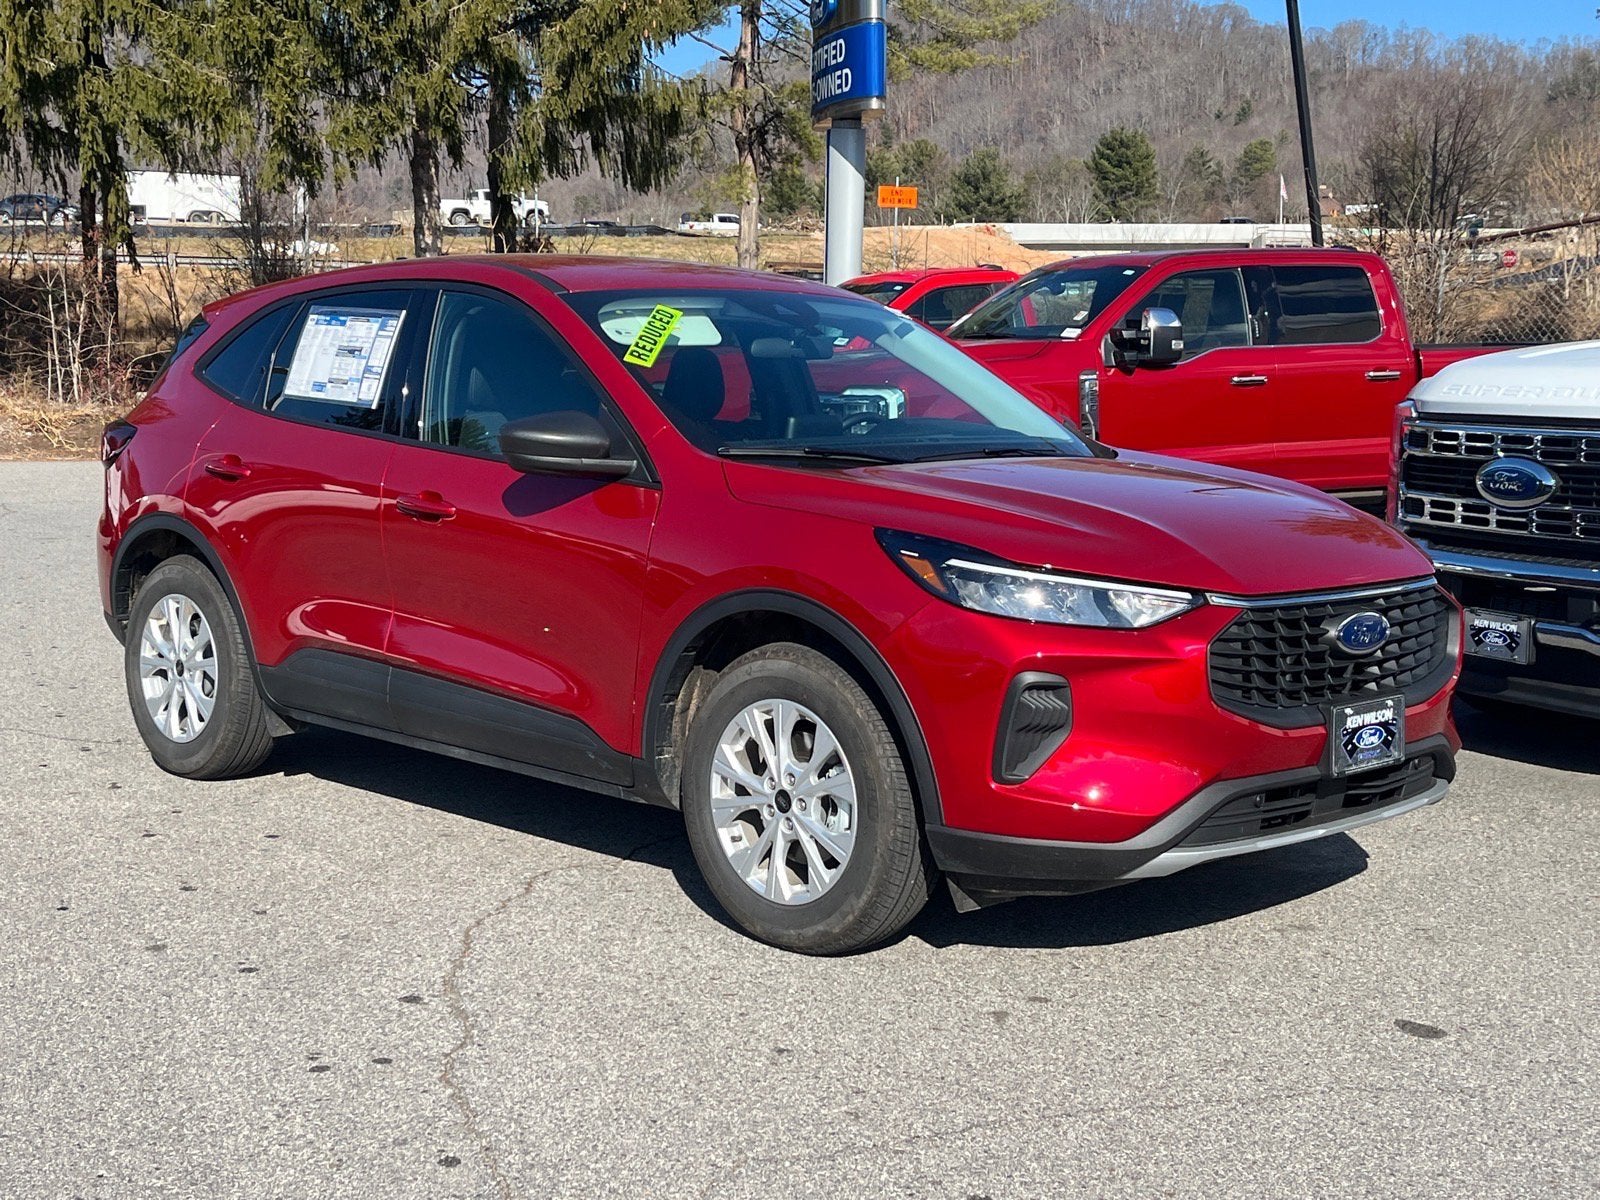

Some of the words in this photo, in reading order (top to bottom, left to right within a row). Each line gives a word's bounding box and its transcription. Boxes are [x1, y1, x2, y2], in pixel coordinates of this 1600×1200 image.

[628, 308, 675, 363] REDUCED
[1440, 383, 1545, 399] SUPER
[1489, 470, 1530, 492] Ford
[1351, 621, 1381, 646] Ford
[1473, 618, 1489, 629] KEN
[1489, 620, 1518, 633] WILSON
[1485, 631, 1504, 644] Ford
[1346, 713, 1365, 729] KEN
[1364, 707, 1394, 726] WILSON
[1360, 728, 1381, 746] Ford
